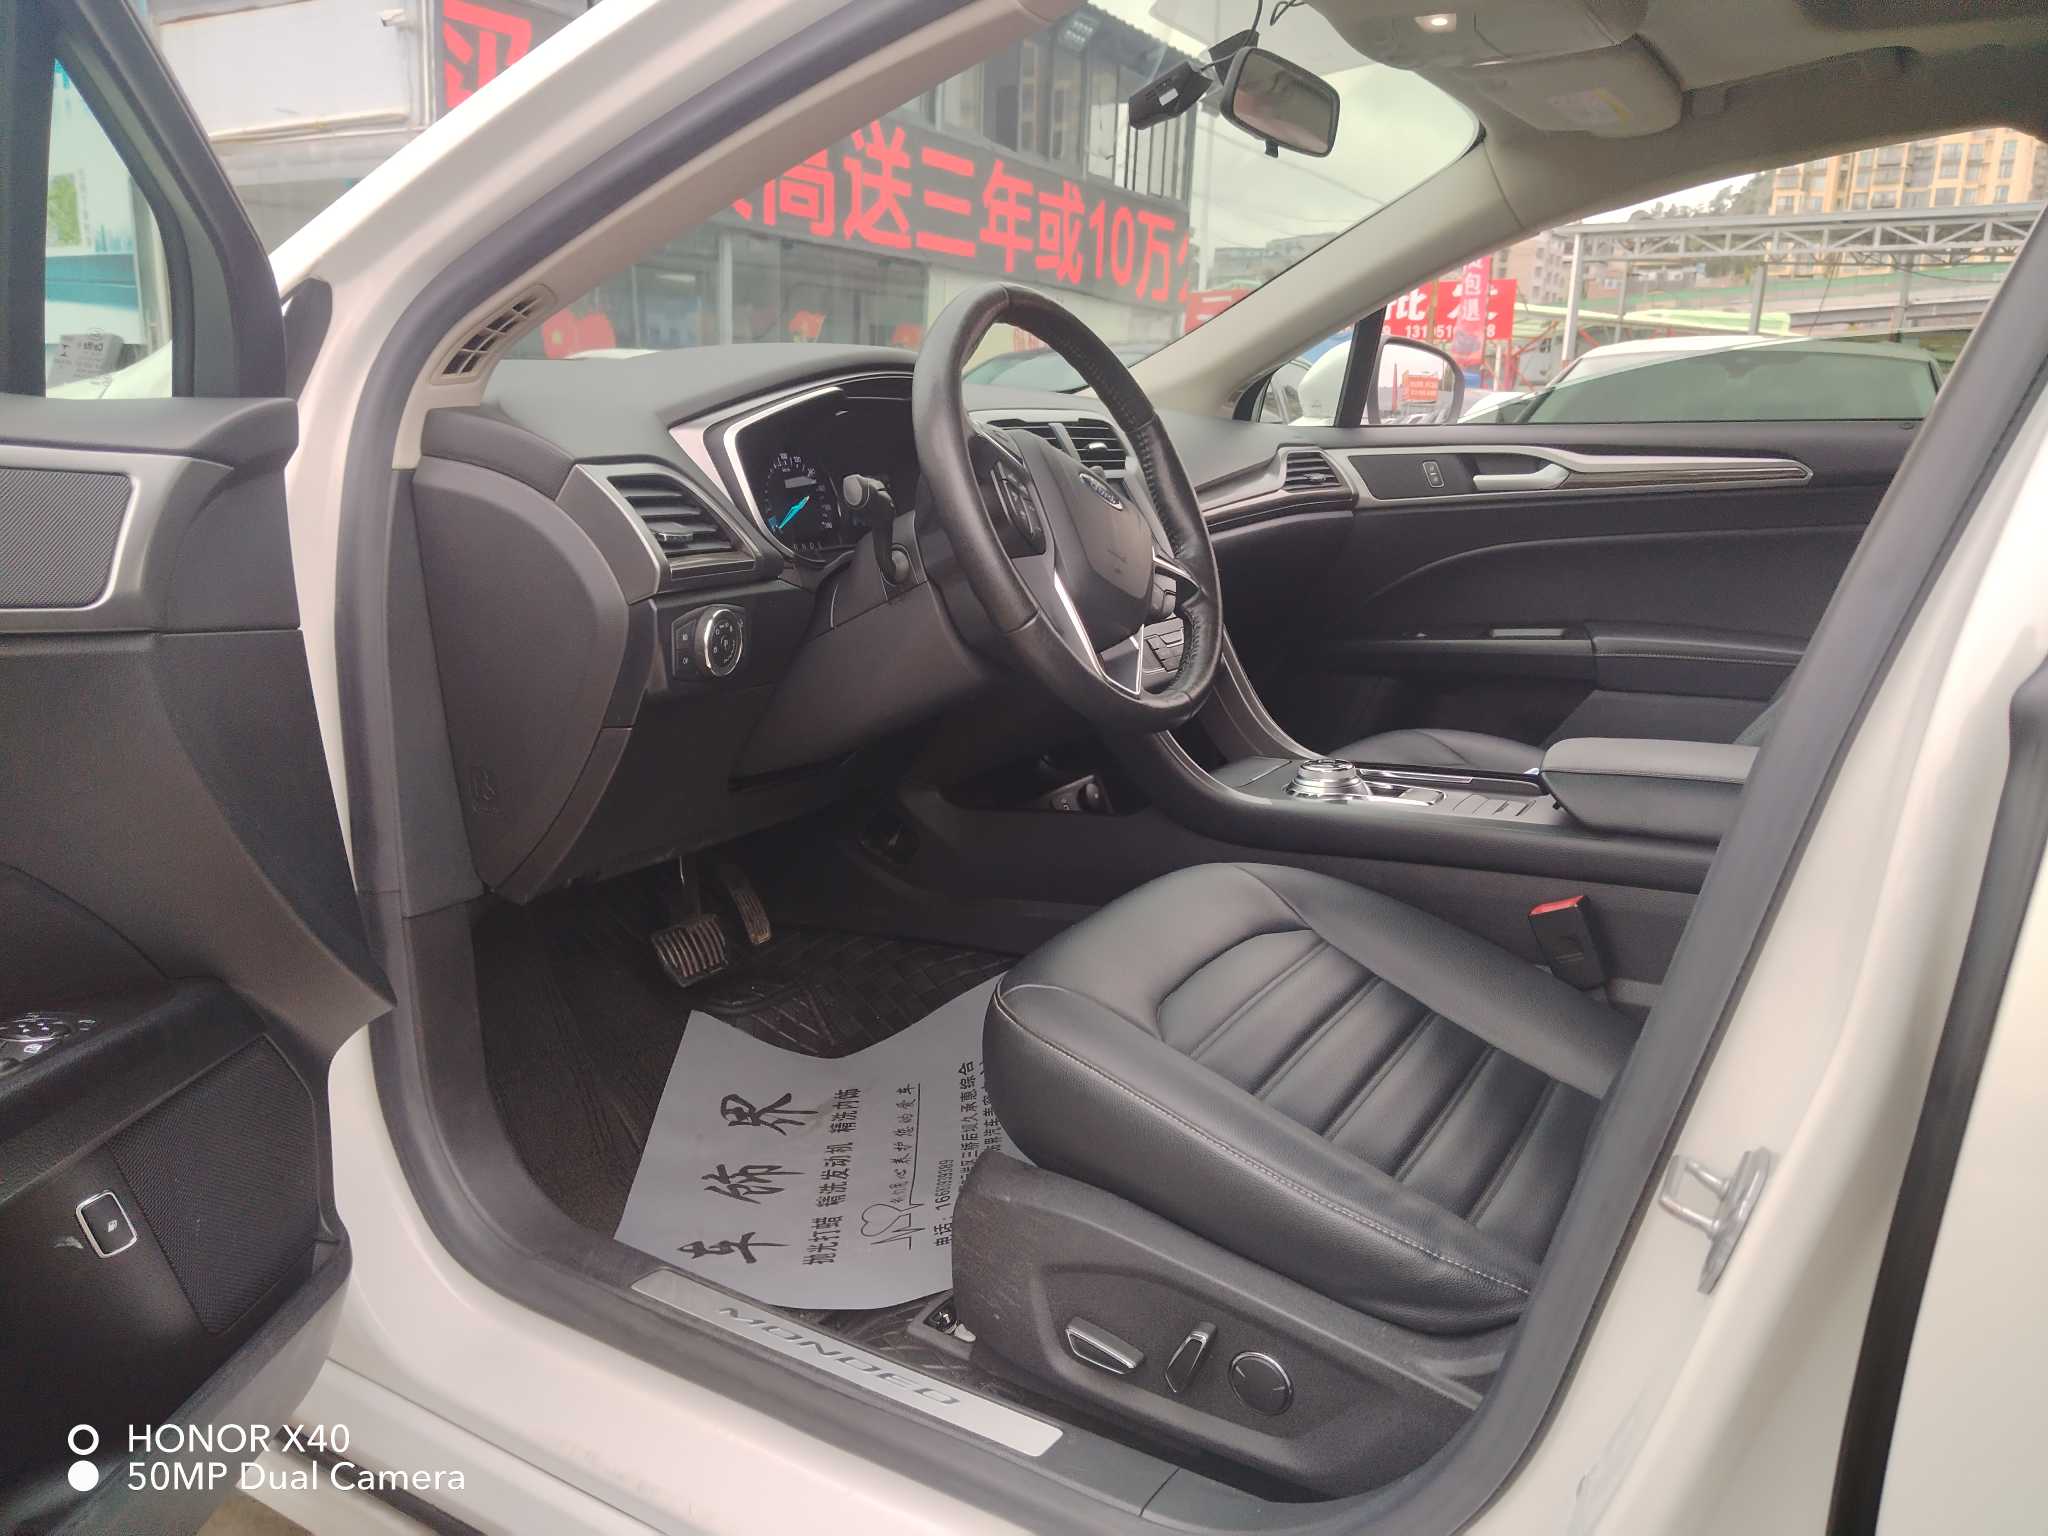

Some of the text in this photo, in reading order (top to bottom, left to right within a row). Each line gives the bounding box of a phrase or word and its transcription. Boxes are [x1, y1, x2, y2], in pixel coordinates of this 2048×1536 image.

[732, 119, 1189, 303] 高送三年或10万
[719, 1307, 960, 1405] MONDEO
